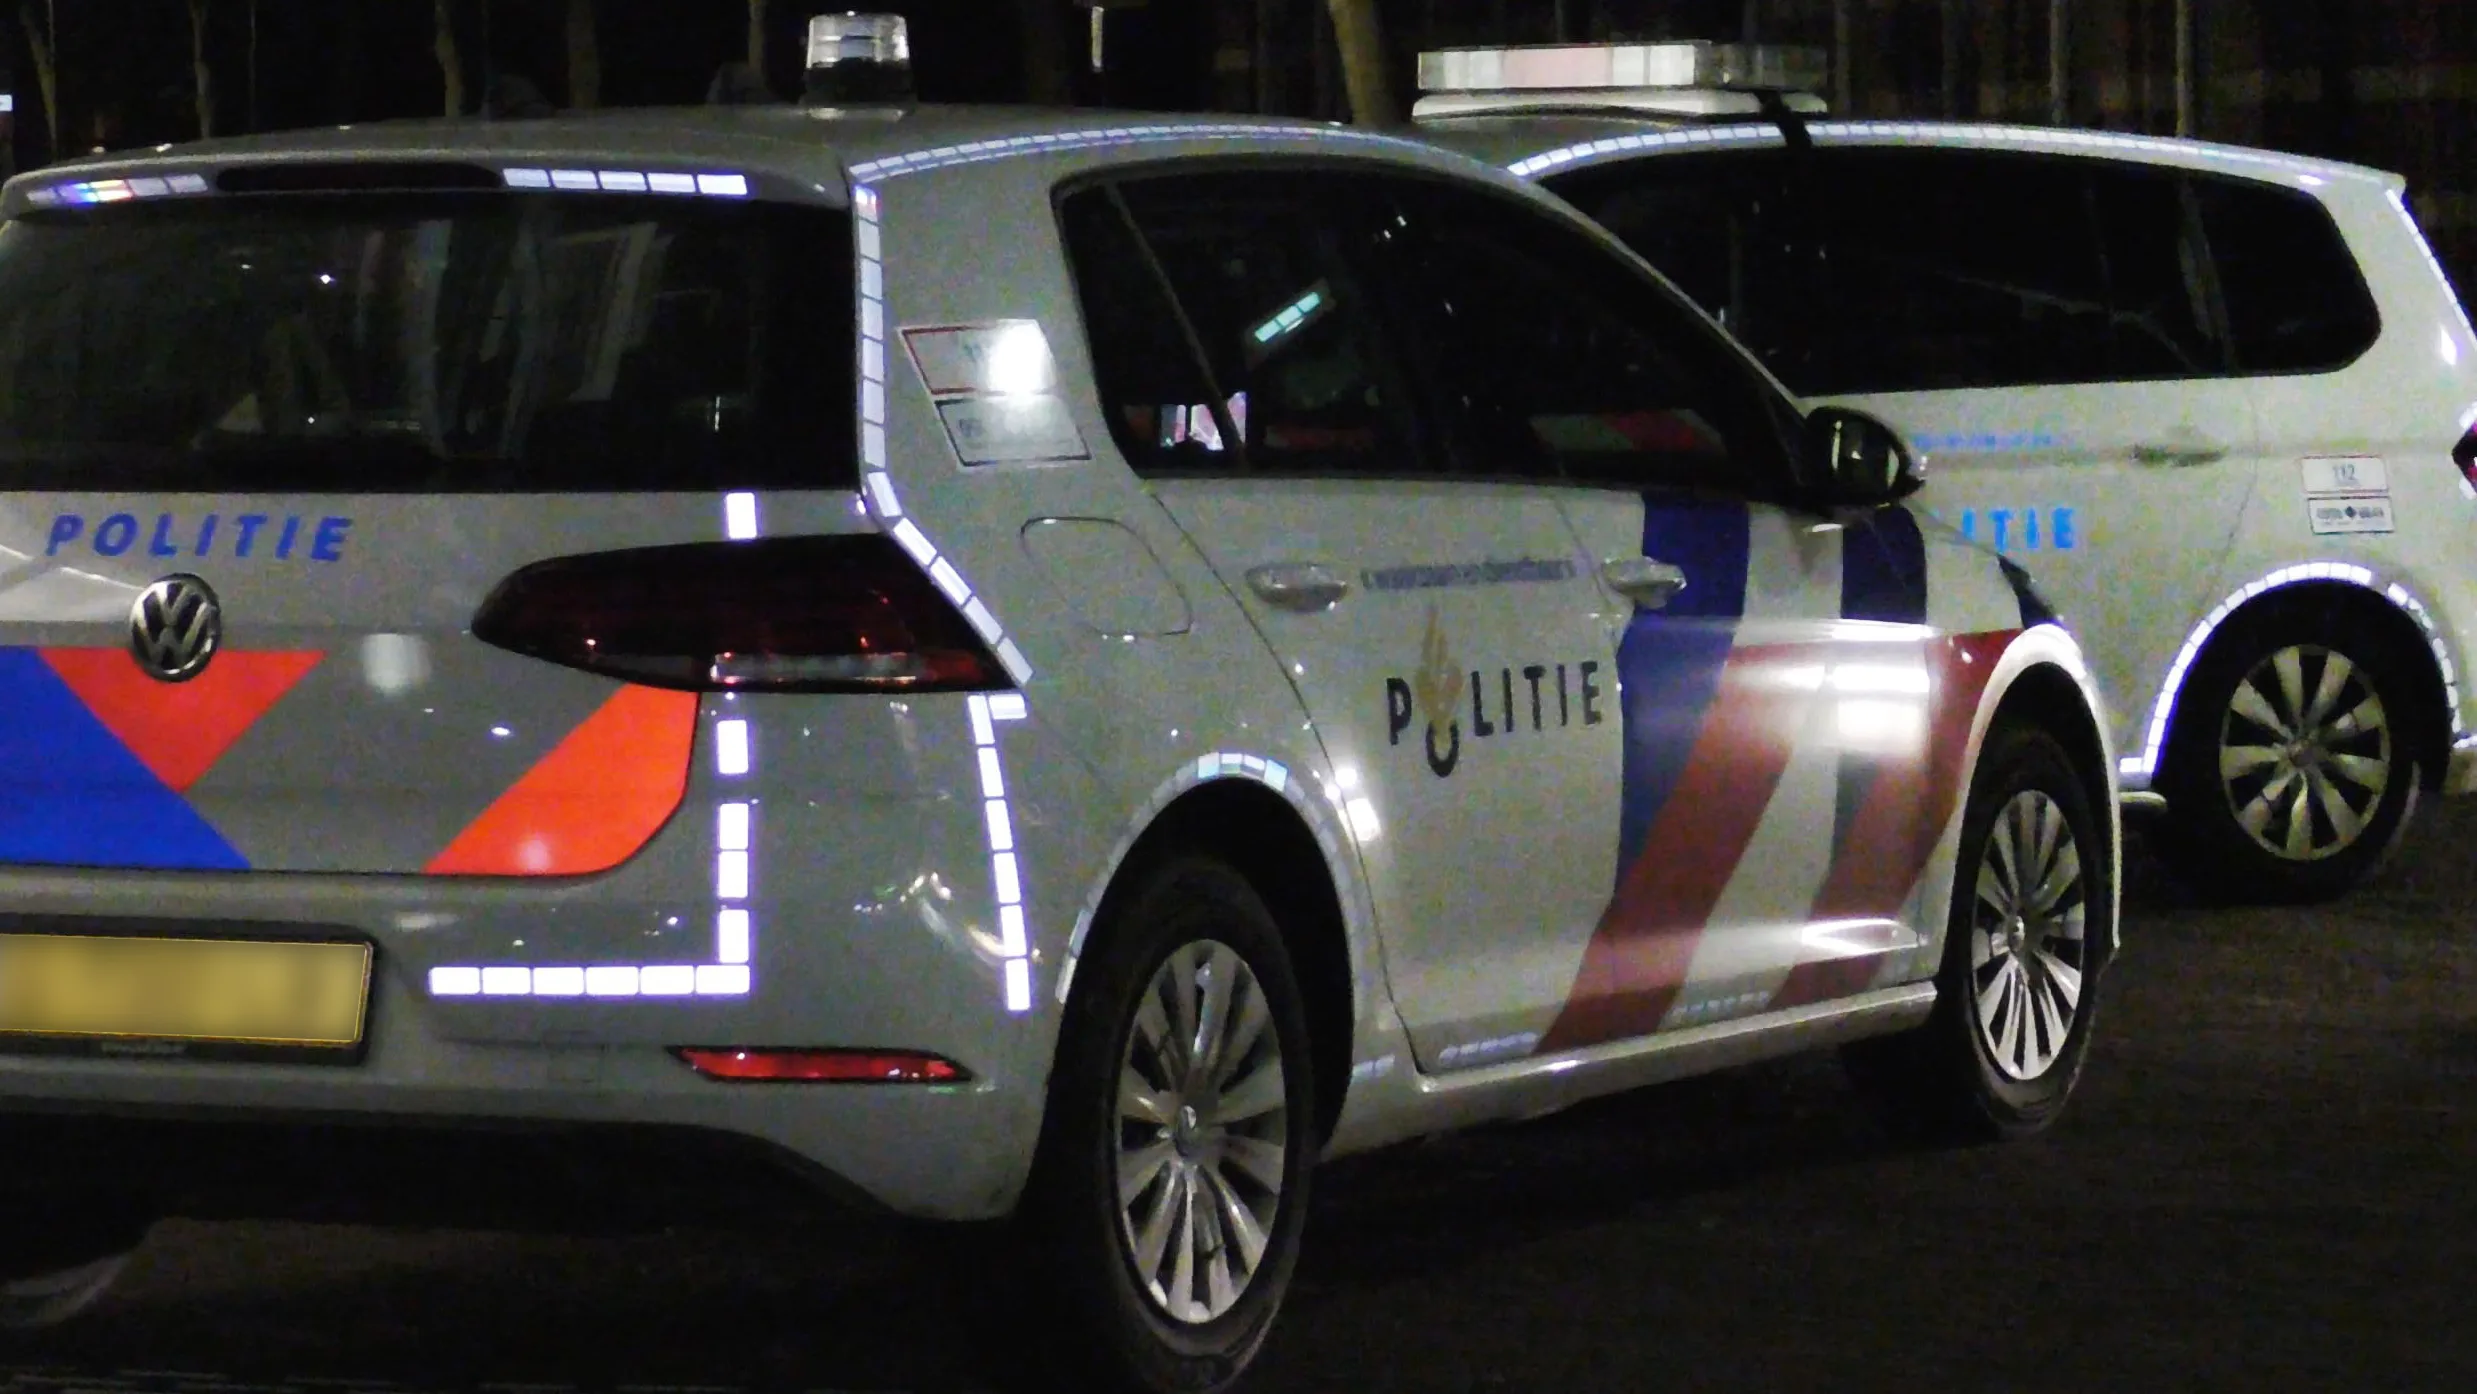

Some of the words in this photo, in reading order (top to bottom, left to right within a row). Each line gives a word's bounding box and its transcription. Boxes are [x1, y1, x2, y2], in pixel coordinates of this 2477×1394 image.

[45, 512, 353, 561] POLITIE
[1960, 506, 2076, 553] ITIE
[1386, 660, 1603, 778] POLITIE
